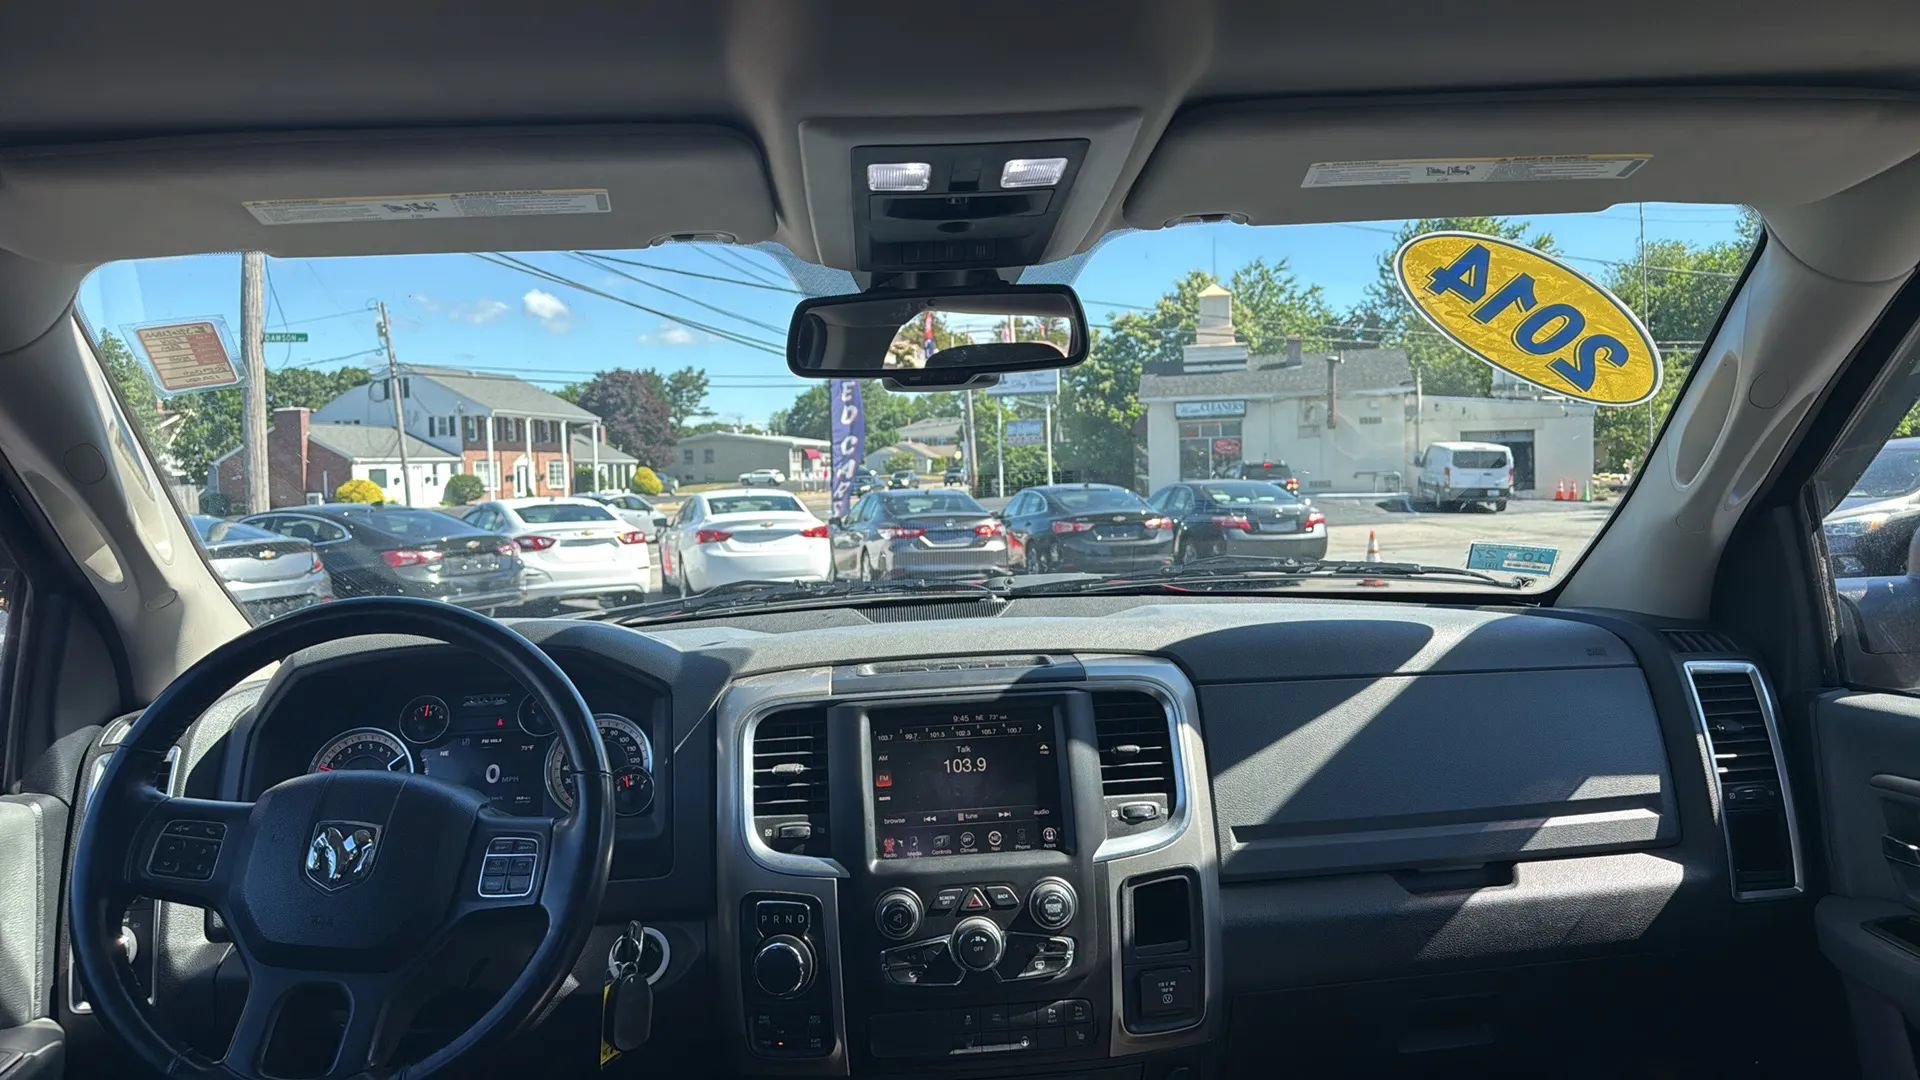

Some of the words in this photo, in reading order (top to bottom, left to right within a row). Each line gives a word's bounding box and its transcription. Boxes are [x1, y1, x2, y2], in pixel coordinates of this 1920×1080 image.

[956, 745, 971, 753] Talk
[943, 757, 987, 774] 103.9
[485, 763, 501, 784] 0
[501, 775, 520, 784] MPH
[1033, 808, 1050, 816] audio
[884, 817, 906, 825] browse
[761, 914, 768, 924] P
[773, 914, 780, 924] R
[785, 914, 793, 924] N
[797, 914, 805, 924] D
